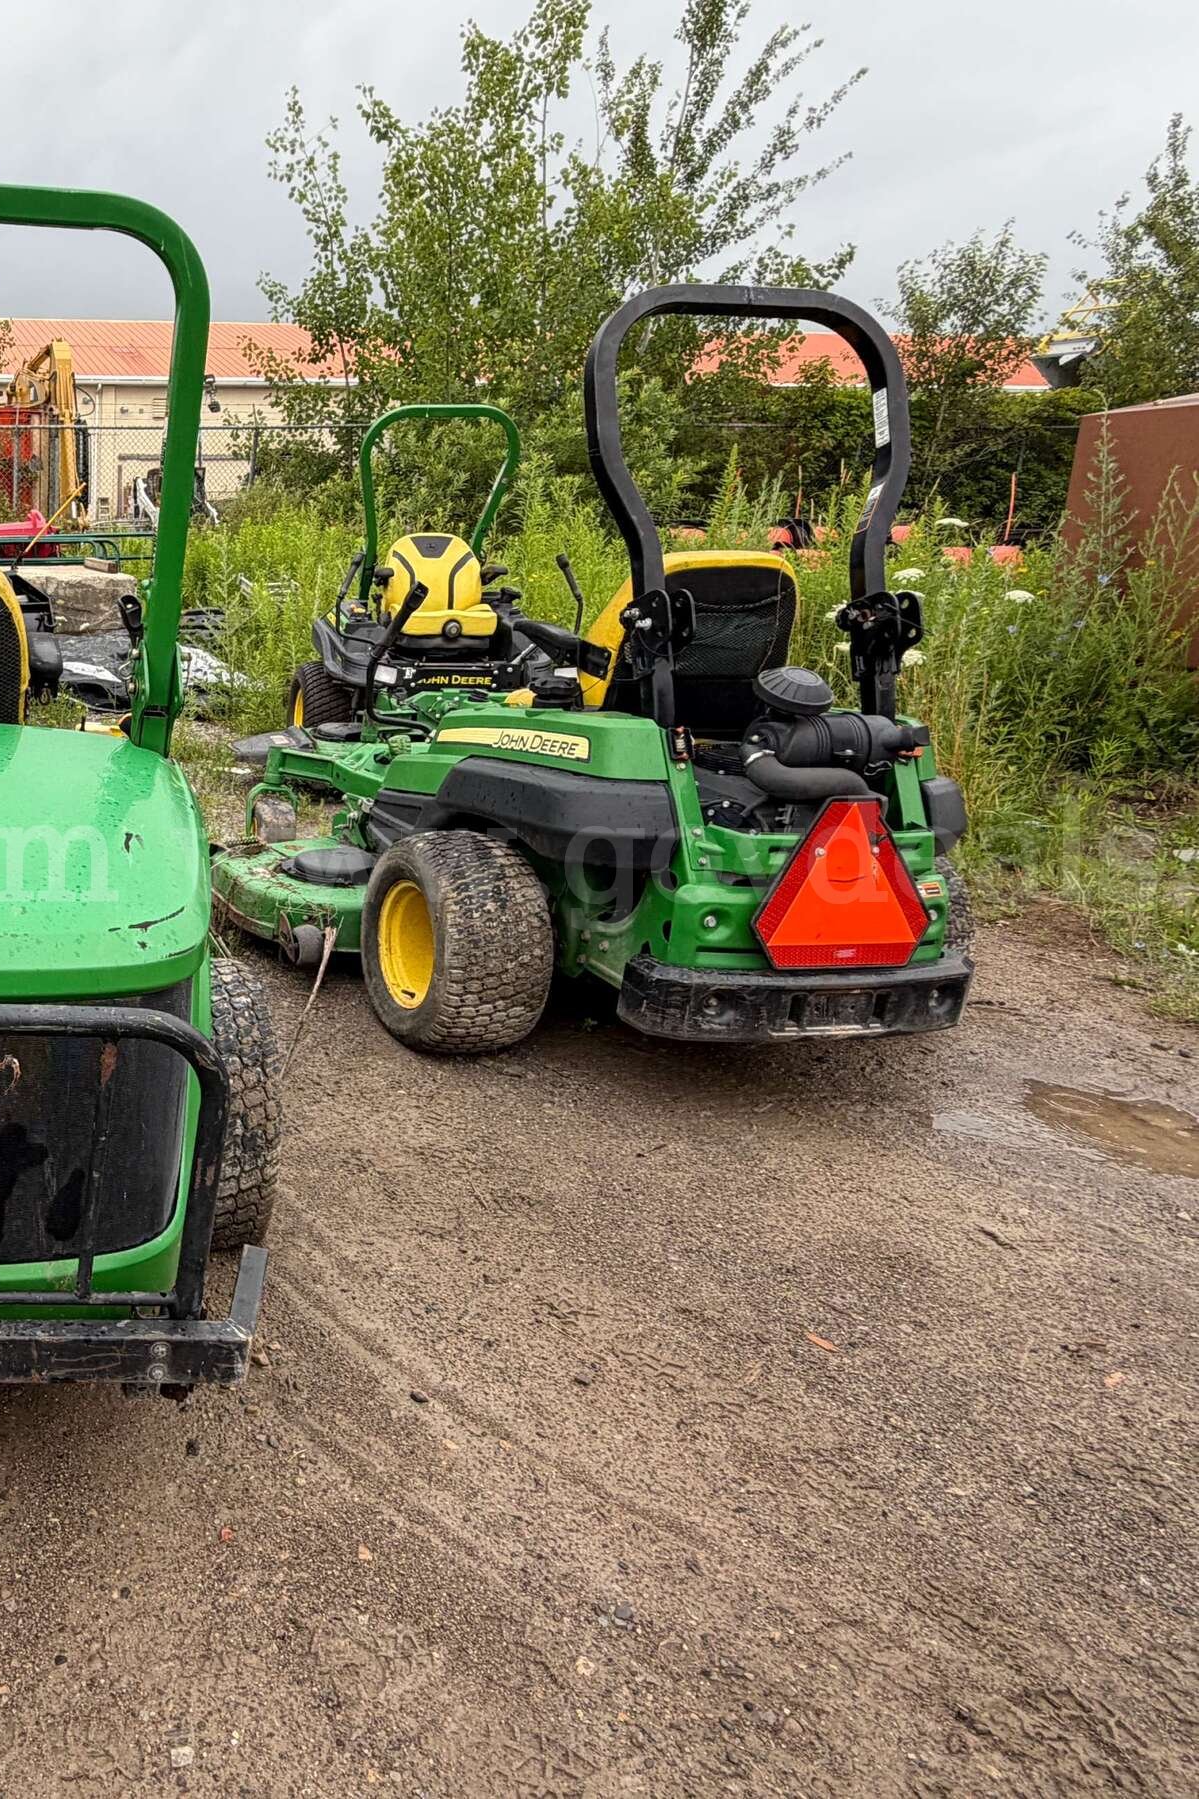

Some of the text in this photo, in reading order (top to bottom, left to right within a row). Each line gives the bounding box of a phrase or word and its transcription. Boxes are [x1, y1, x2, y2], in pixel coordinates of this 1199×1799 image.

[451, 674, 493, 685] DEERE
[493, 730, 579, 756] JOHN DEERE
